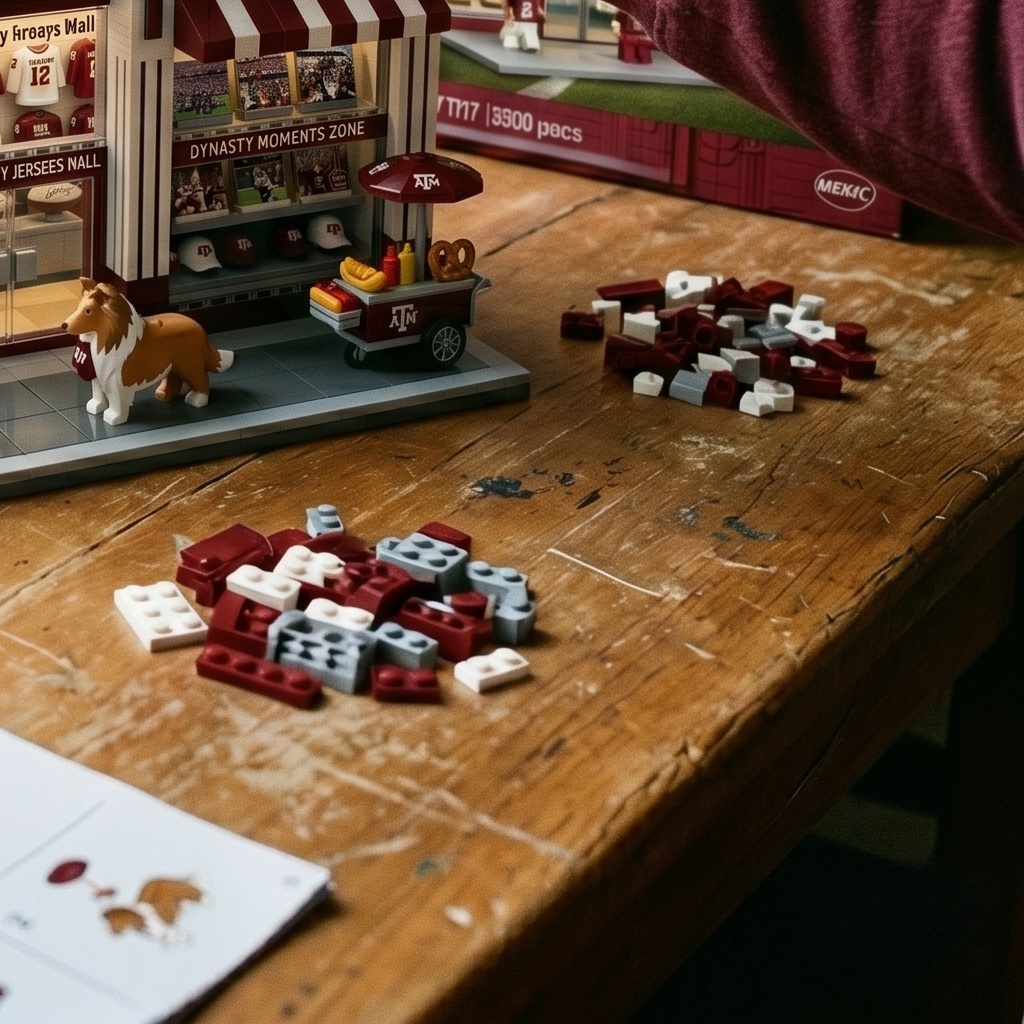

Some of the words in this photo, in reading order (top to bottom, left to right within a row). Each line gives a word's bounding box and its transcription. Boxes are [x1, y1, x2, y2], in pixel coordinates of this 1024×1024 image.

[29, 65, 51, 87] 12
[190, 136, 255, 160] DYNASTY
[257, 126, 326, 153] MOMENTS
[328, 120, 366, 140] ZONE
[12, 157, 65, 181] JERSEES
